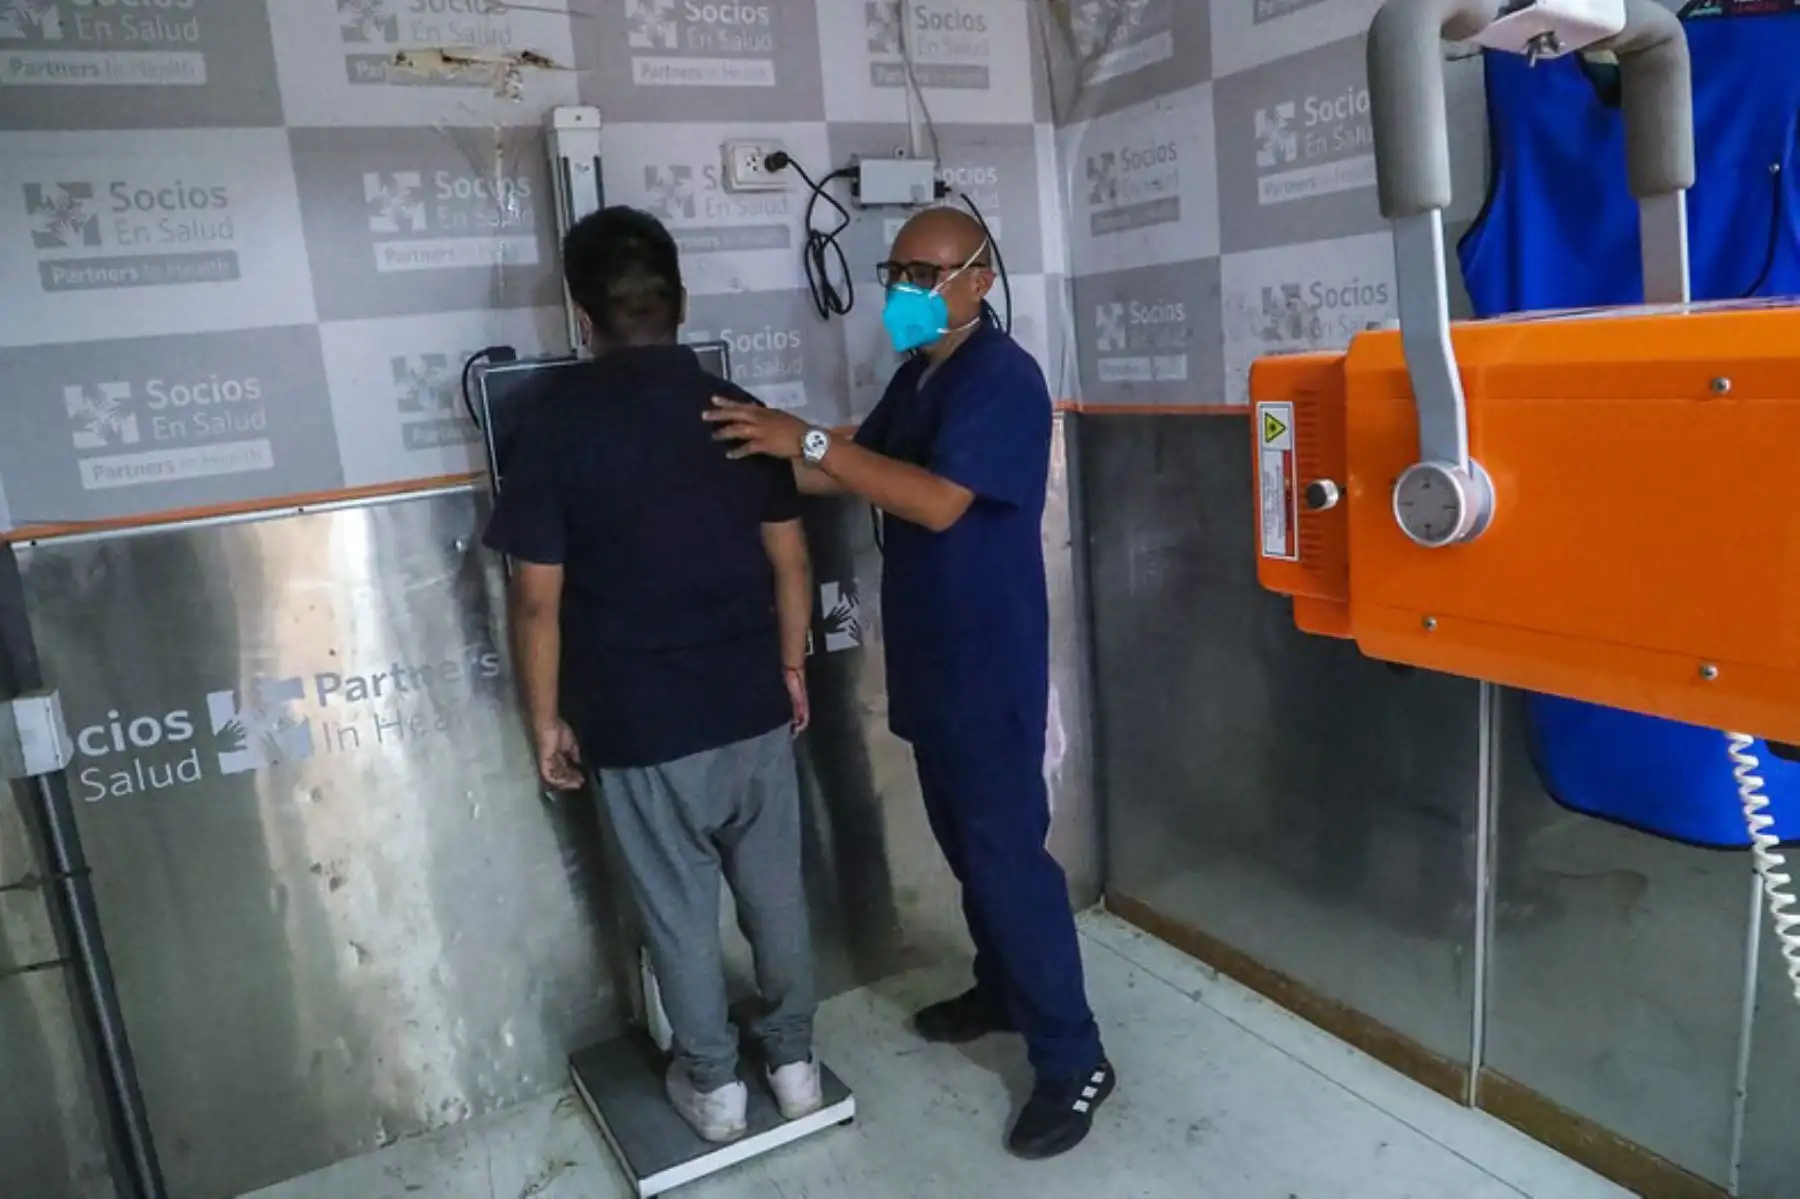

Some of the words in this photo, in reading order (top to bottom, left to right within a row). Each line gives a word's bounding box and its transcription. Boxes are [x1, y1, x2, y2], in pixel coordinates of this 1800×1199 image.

[684, 0, 771, 25] Socios
[915, 5, 988, 33] Socios
[75, 13, 113, 41] En
[120, 13, 200, 42] Salud
[411, 17, 441, 43] En
[448, 18, 512, 46] Salud
[687, 25, 714, 49] En
[8, 56, 100, 78] Partners
[1304, 84, 1371, 127] Socio
[1333, 123, 1373, 151] Salu
[1120, 141, 1178, 172] Socios
[108, 178, 229, 213] Socios
[114, 217, 150, 245] En
[157, 214, 235, 243] Salud
[436, 204, 468, 230] En
[53, 265, 140, 285] Partners
[1309, 275, 1389, 310] Socios
[720, 325, 801, 352] Socios
[146, 373, 262, 410] Socios
[151, 416, 187, 441] En
[192, 404, 267, 436] Salud
[92, 458, 177, 482] Partners
[77, 709, 194, 757] cios
[322, 718, 361, 753] In
[80, 747, 202, 802] Salud
